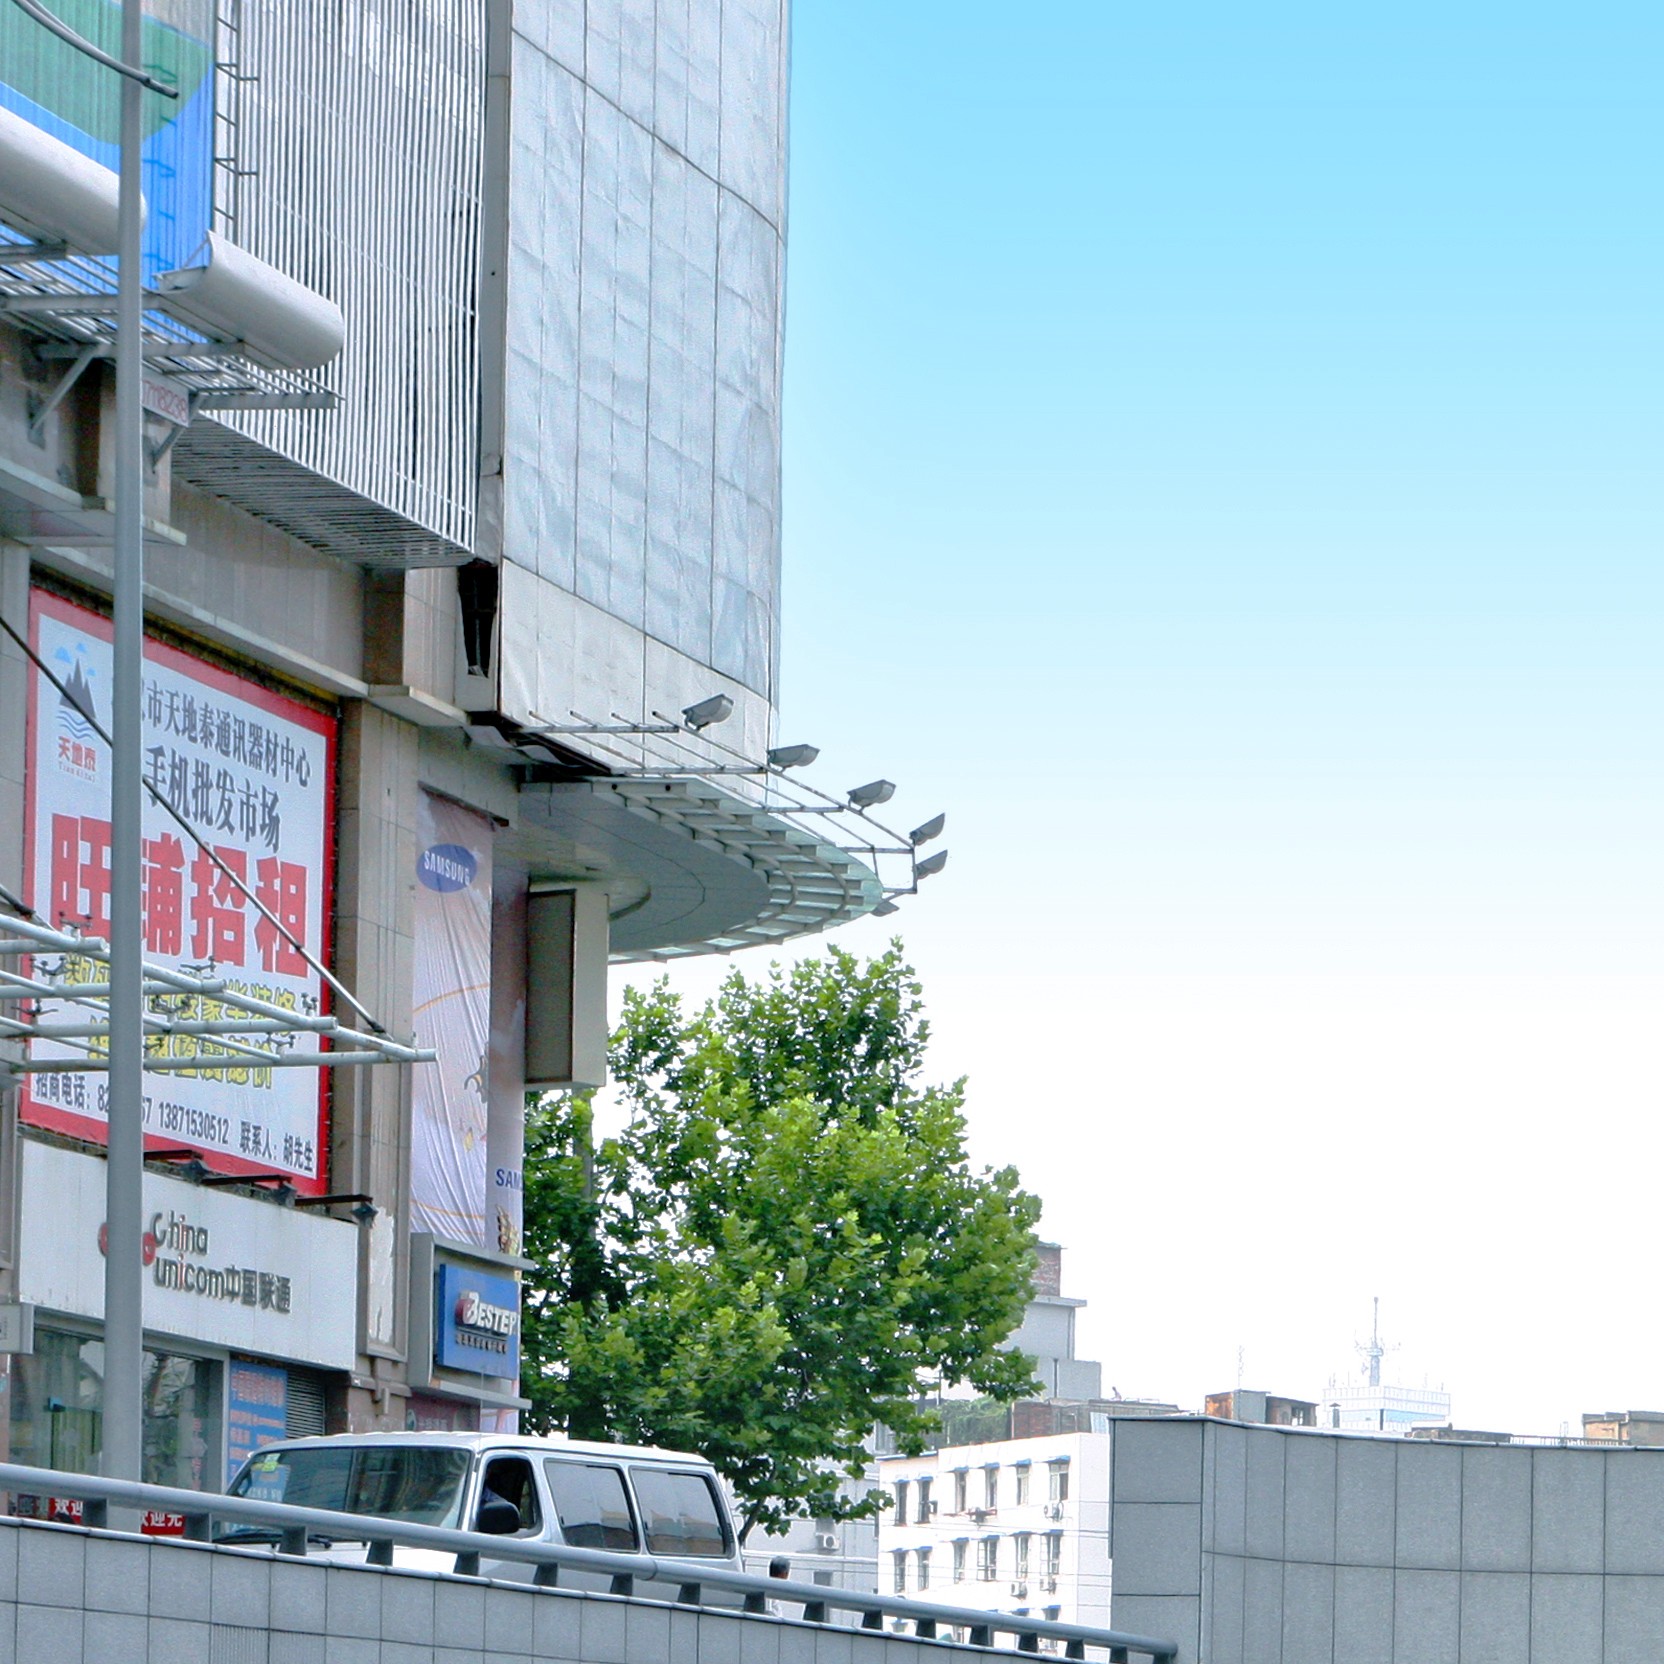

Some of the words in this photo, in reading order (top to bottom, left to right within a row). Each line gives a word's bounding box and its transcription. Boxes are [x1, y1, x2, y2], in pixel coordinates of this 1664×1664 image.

[145, 745, 281, 853] 手机批发市场
[424, 850, 470, 887] SAMSUNG
[158, 1101, 229, 1145] 13871530512
[153, 1210, 209, 1256] China
